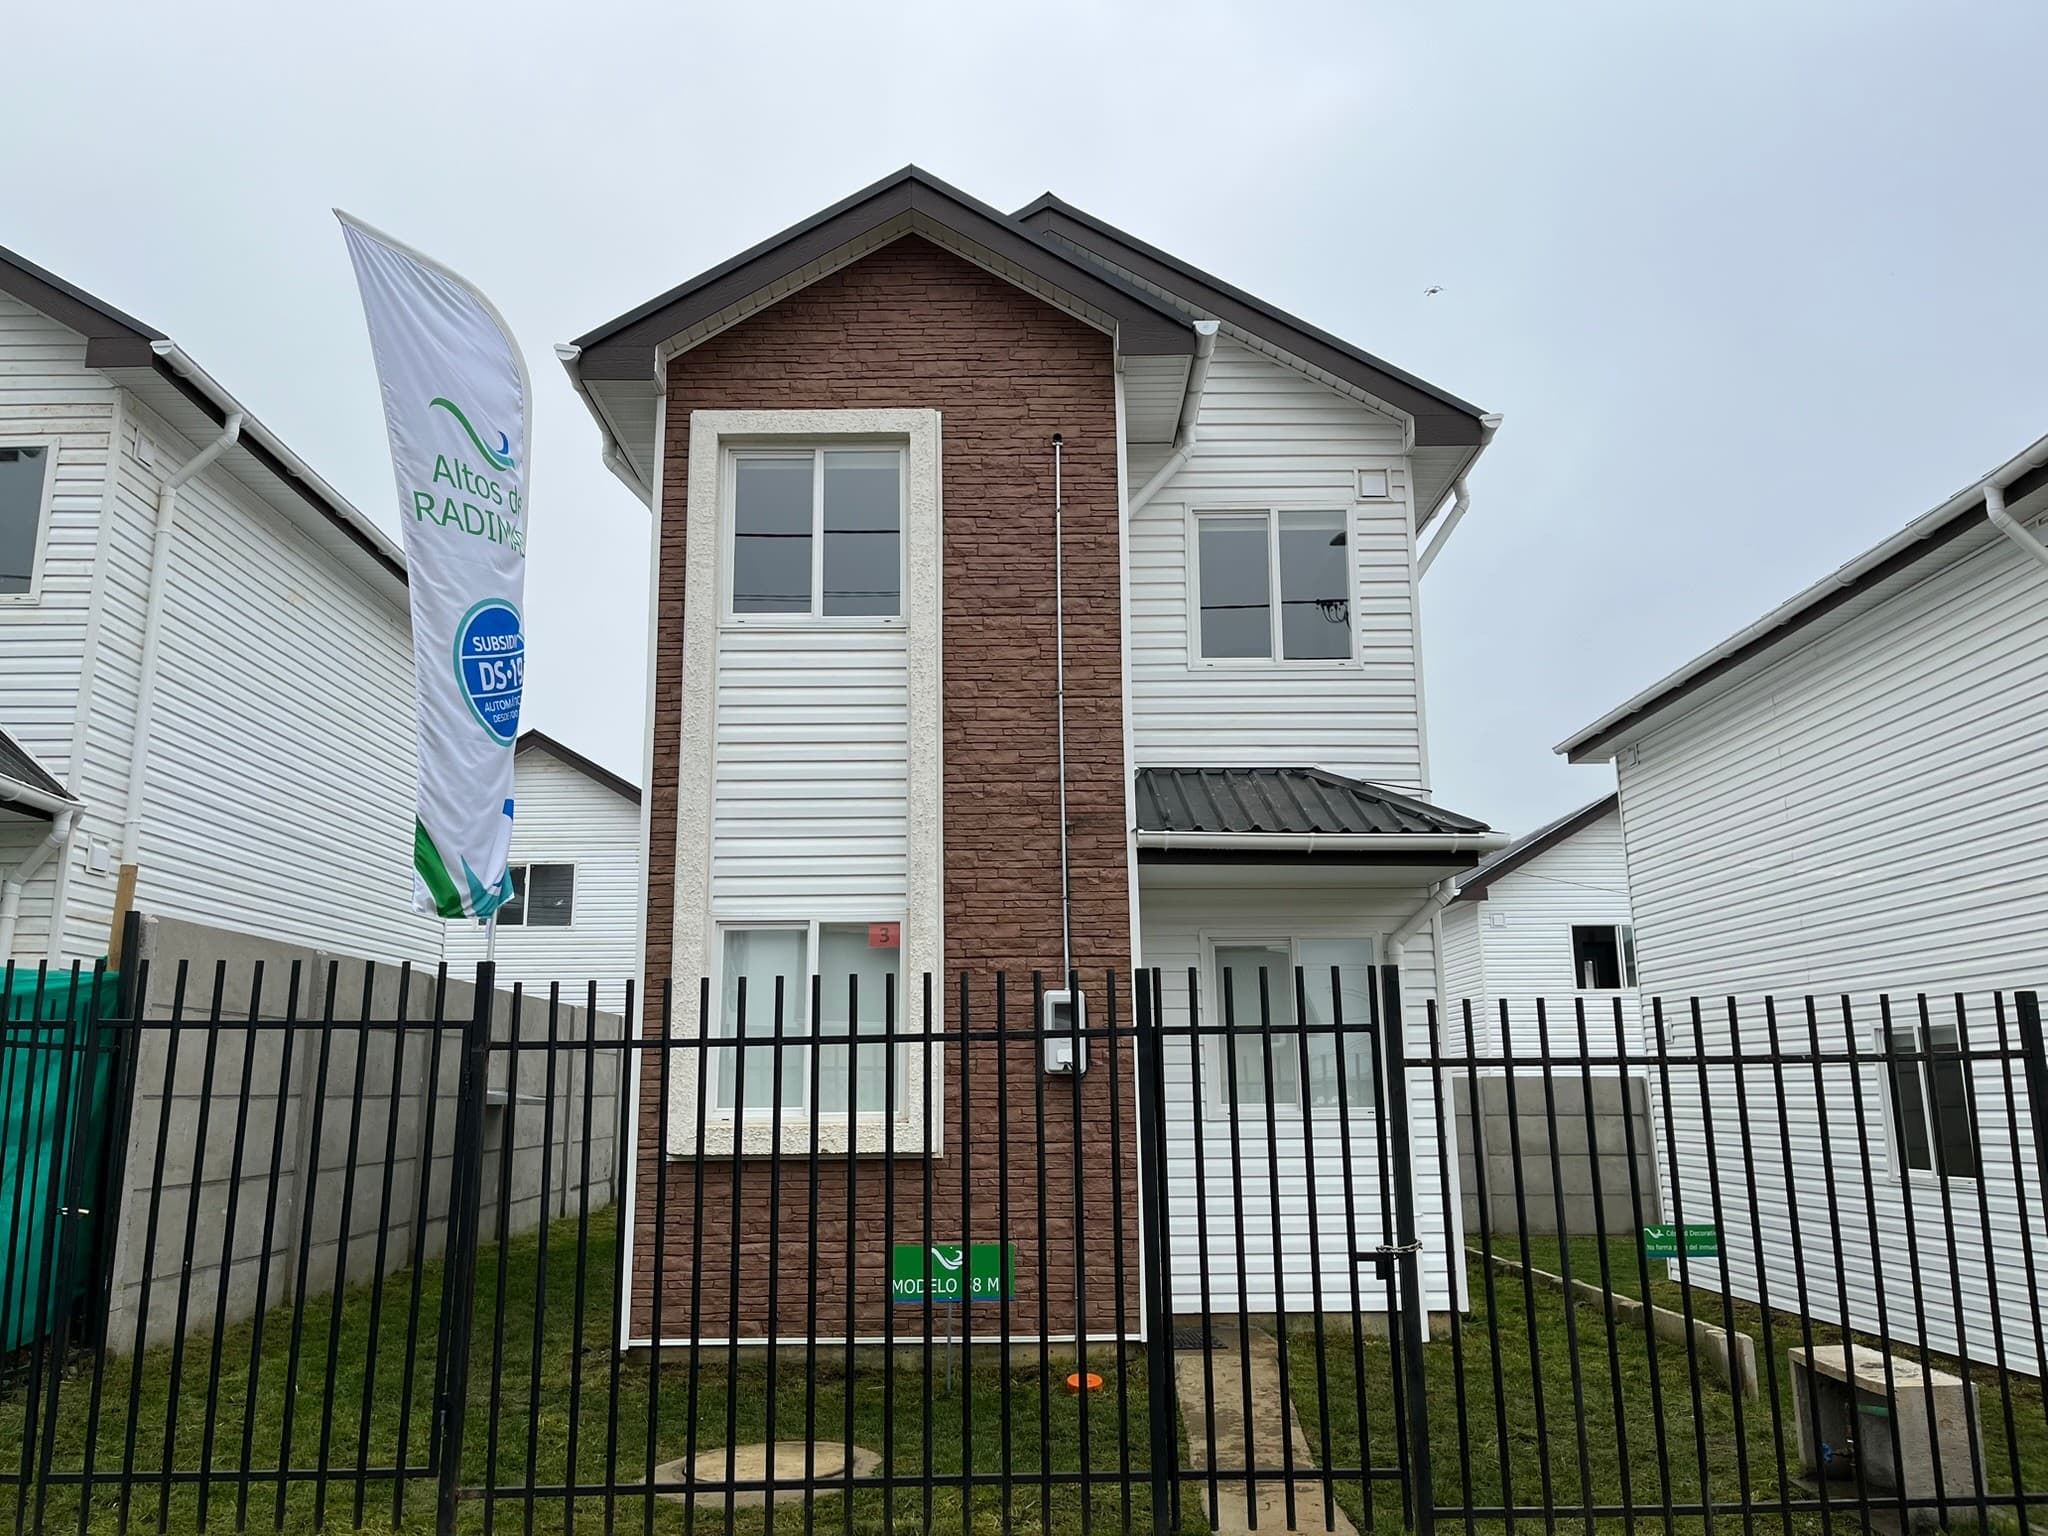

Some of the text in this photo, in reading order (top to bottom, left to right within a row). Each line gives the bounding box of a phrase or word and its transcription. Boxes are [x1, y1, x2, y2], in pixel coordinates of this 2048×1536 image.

[432, 454, 503, 506] Altos
[879, 927, 890, 943] 3
[892, 1278, 958, 1294] MODELO
[969, 1277, 982, 1293] 8
